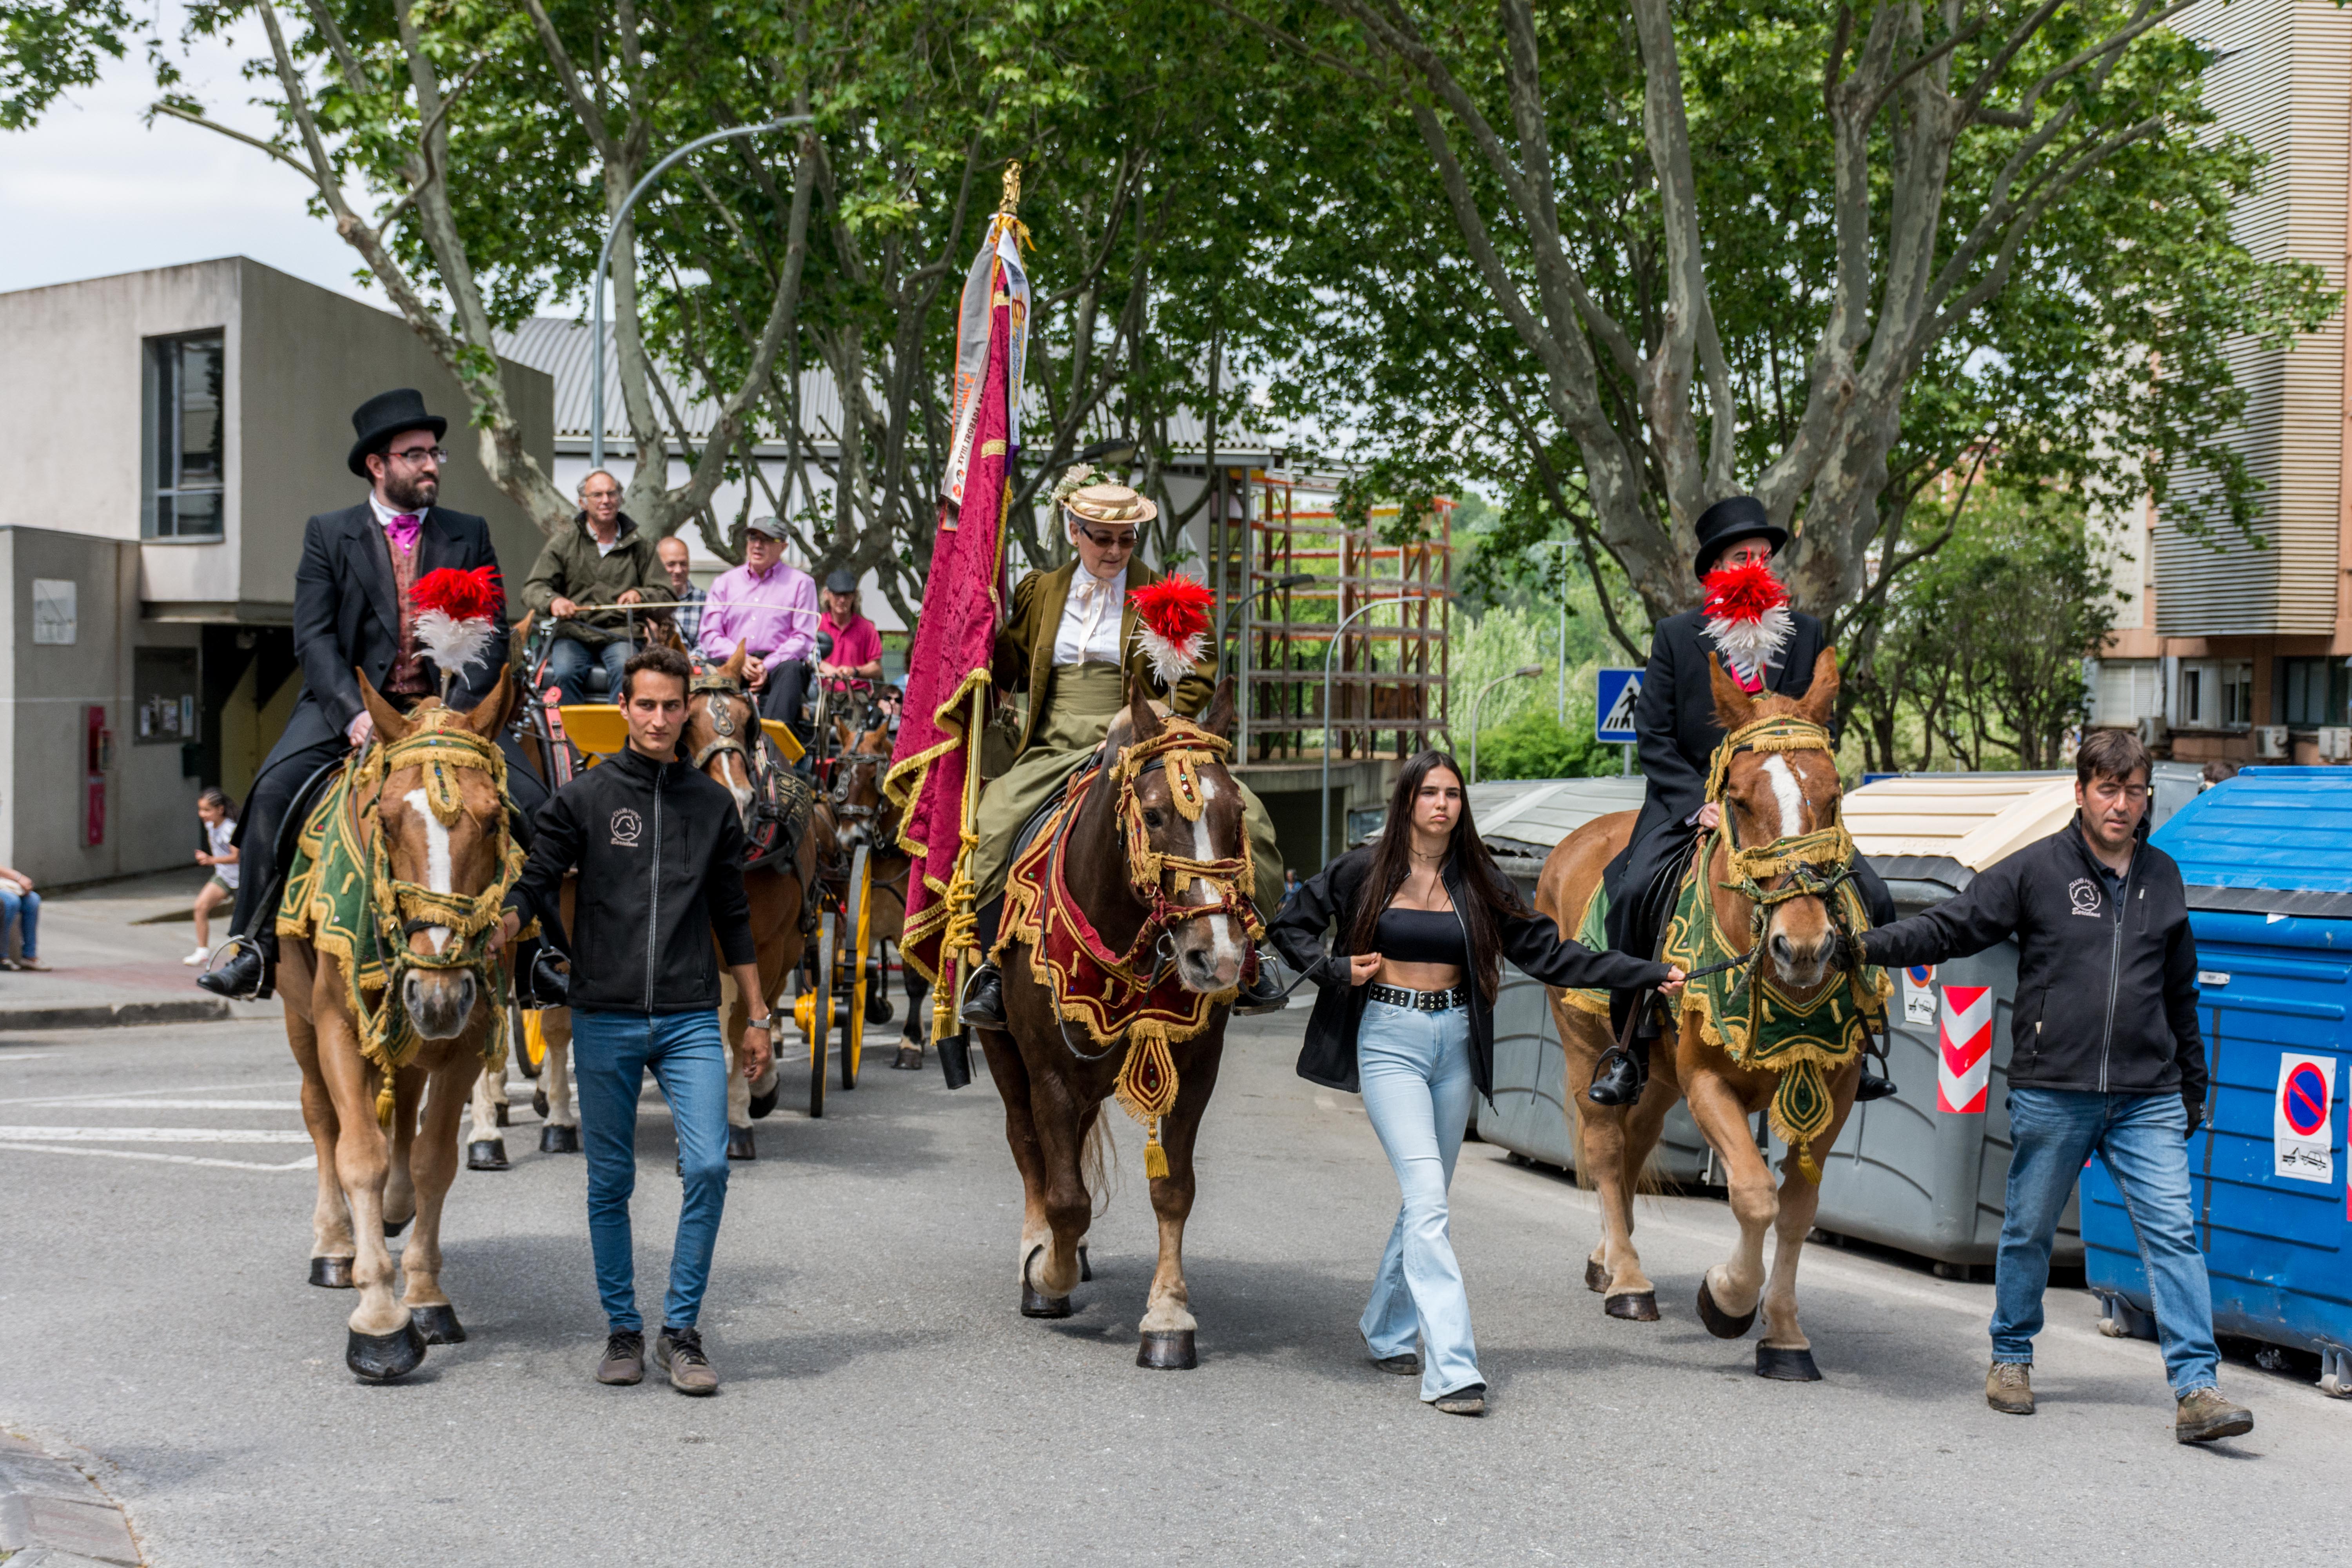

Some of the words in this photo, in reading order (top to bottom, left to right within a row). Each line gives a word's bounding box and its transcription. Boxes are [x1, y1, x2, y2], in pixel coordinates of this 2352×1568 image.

[958, 445, 968, 465] XVIII
[964, 407, 981, 444] TROBADA
[613, 808, 628, 817] CLUB
[611, 837, 639, 847] Barcelona
[2069, 878, 2084, 889] CLUB
[2072, 907, 2101, 918] Barcelona
